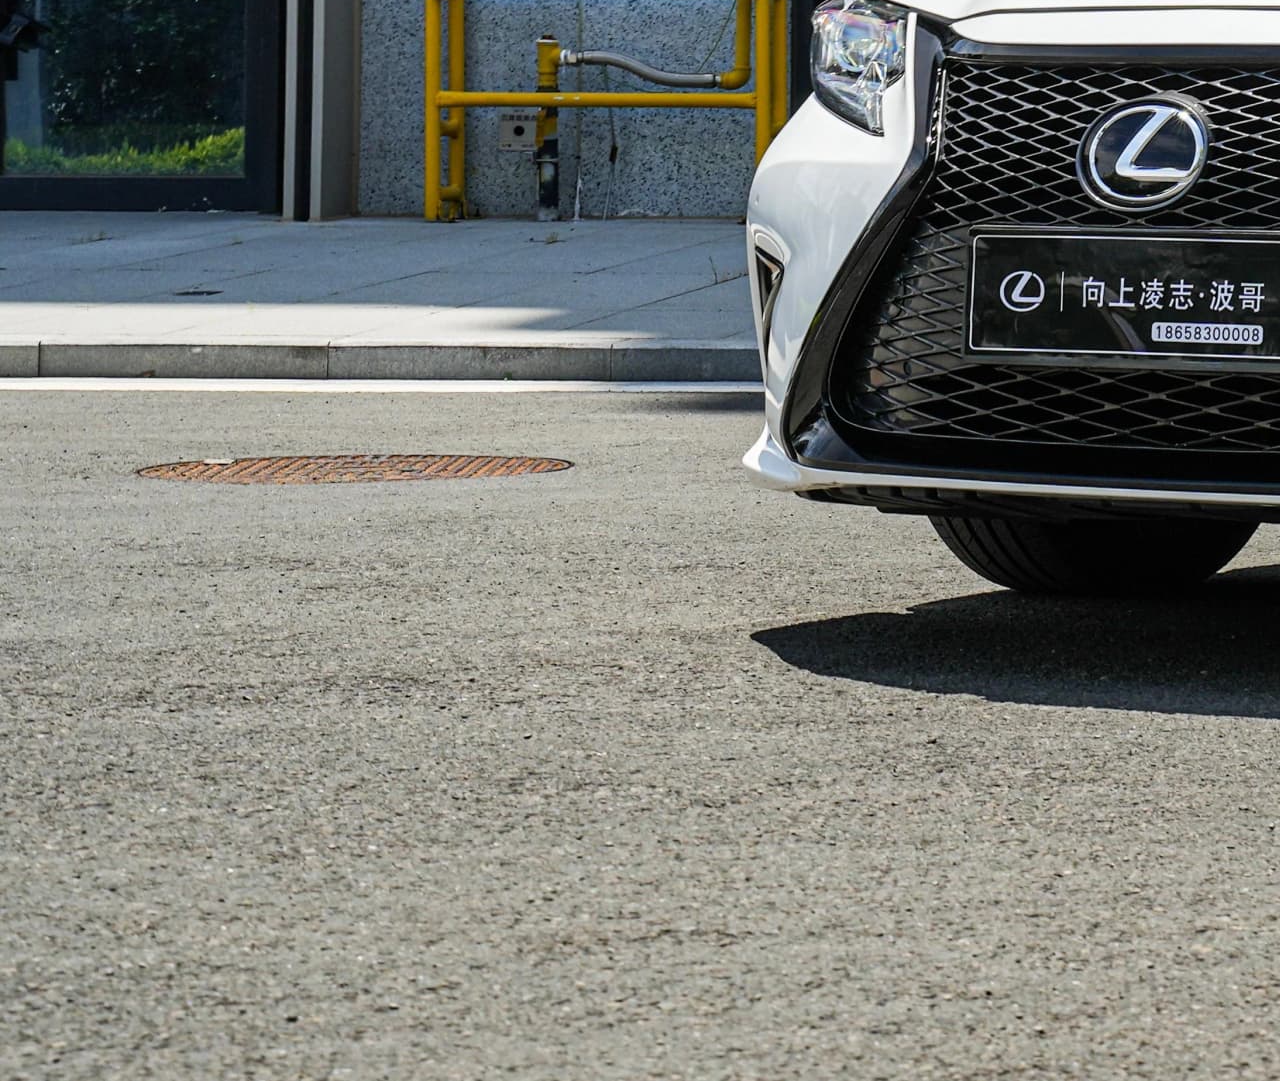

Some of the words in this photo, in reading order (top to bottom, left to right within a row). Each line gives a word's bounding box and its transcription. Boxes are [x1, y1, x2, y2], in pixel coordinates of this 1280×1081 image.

[1081, 276, 1266, 313] 向上凌志·波哥
[1155, 324, 1261, 343] 18658300008
